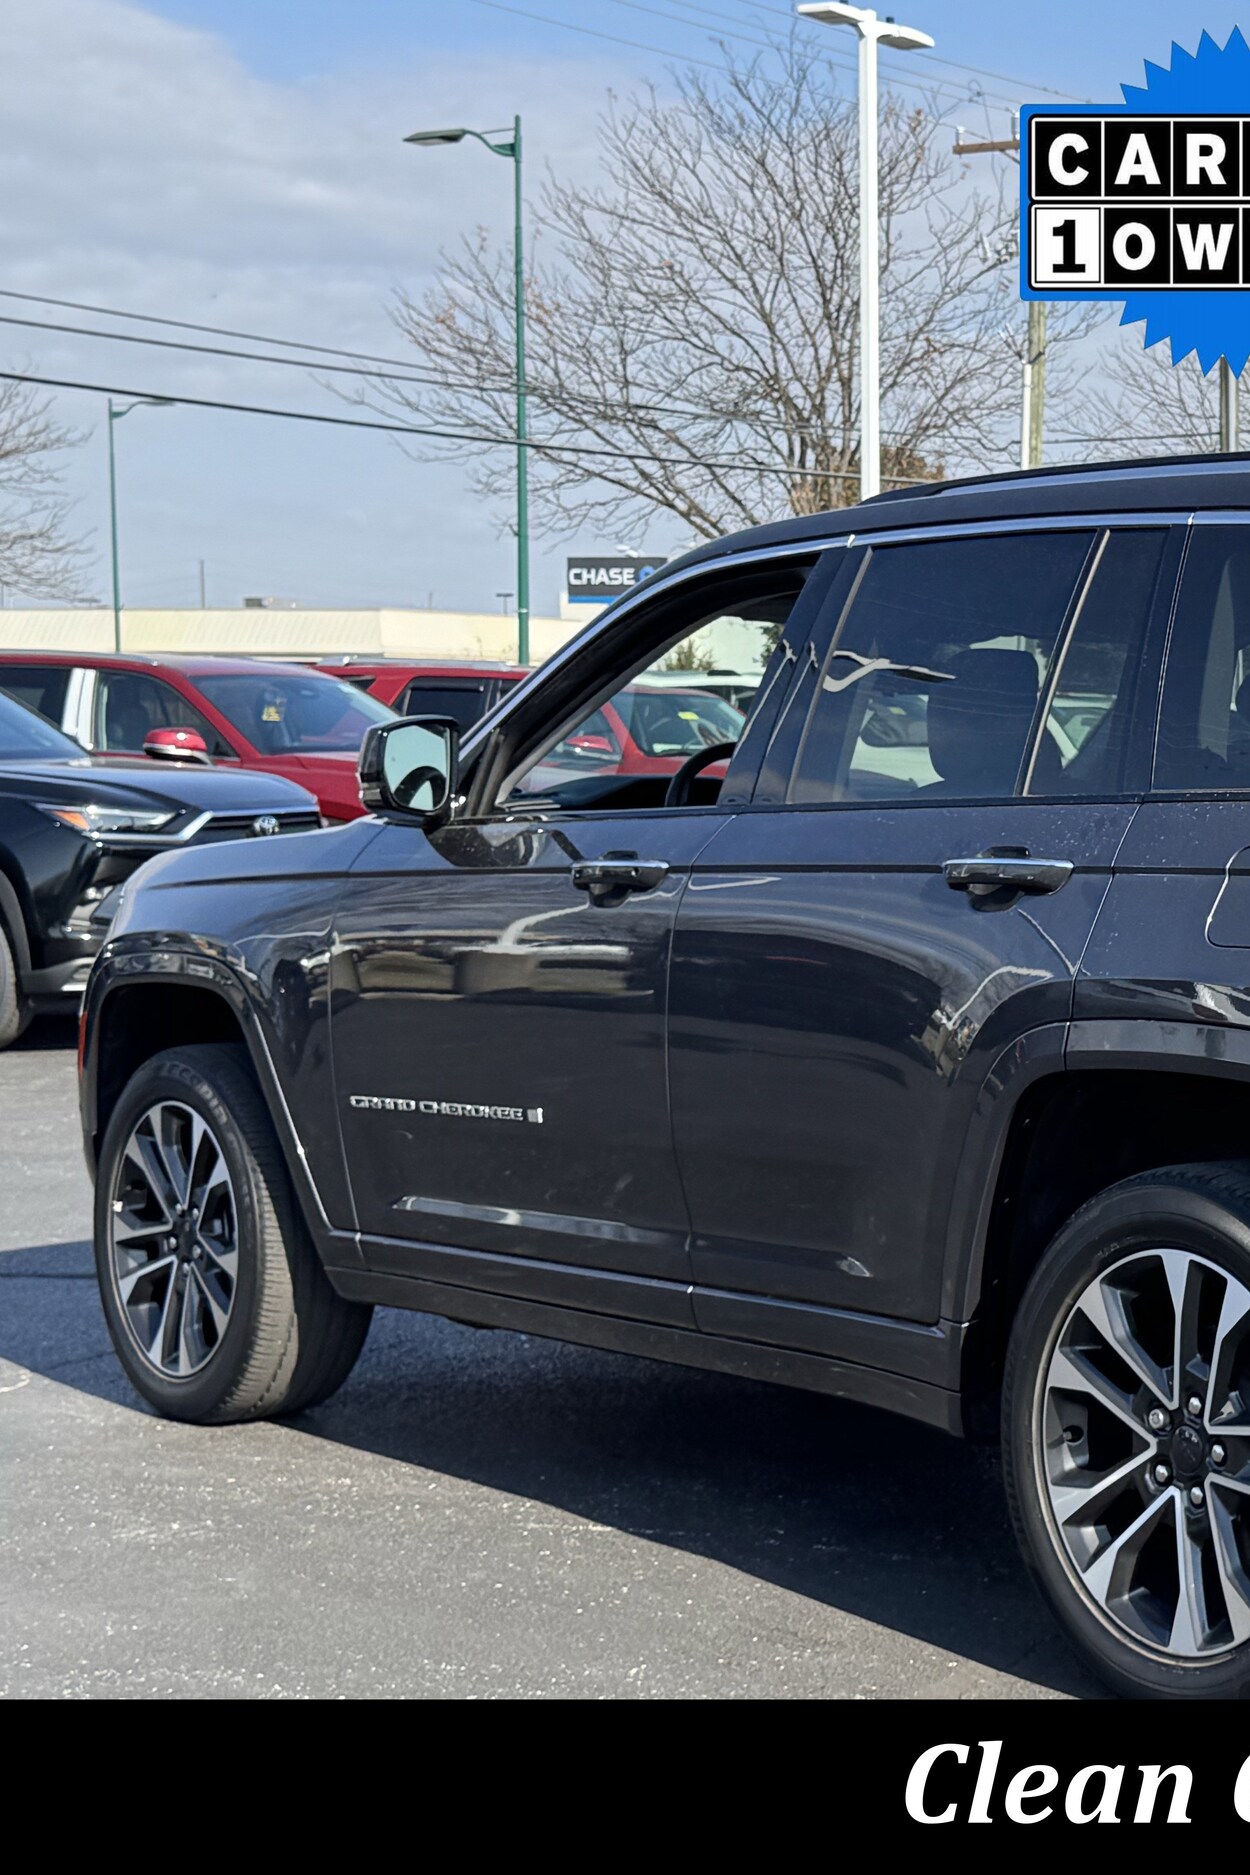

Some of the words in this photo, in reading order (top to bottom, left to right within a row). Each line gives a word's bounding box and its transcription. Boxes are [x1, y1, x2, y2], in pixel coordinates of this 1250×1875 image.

[568, 567, 636, 585] CHASE
[350, 1095, 416, 1111] GRAND
[419, 1101, 524, 1121] CHEROKEE
